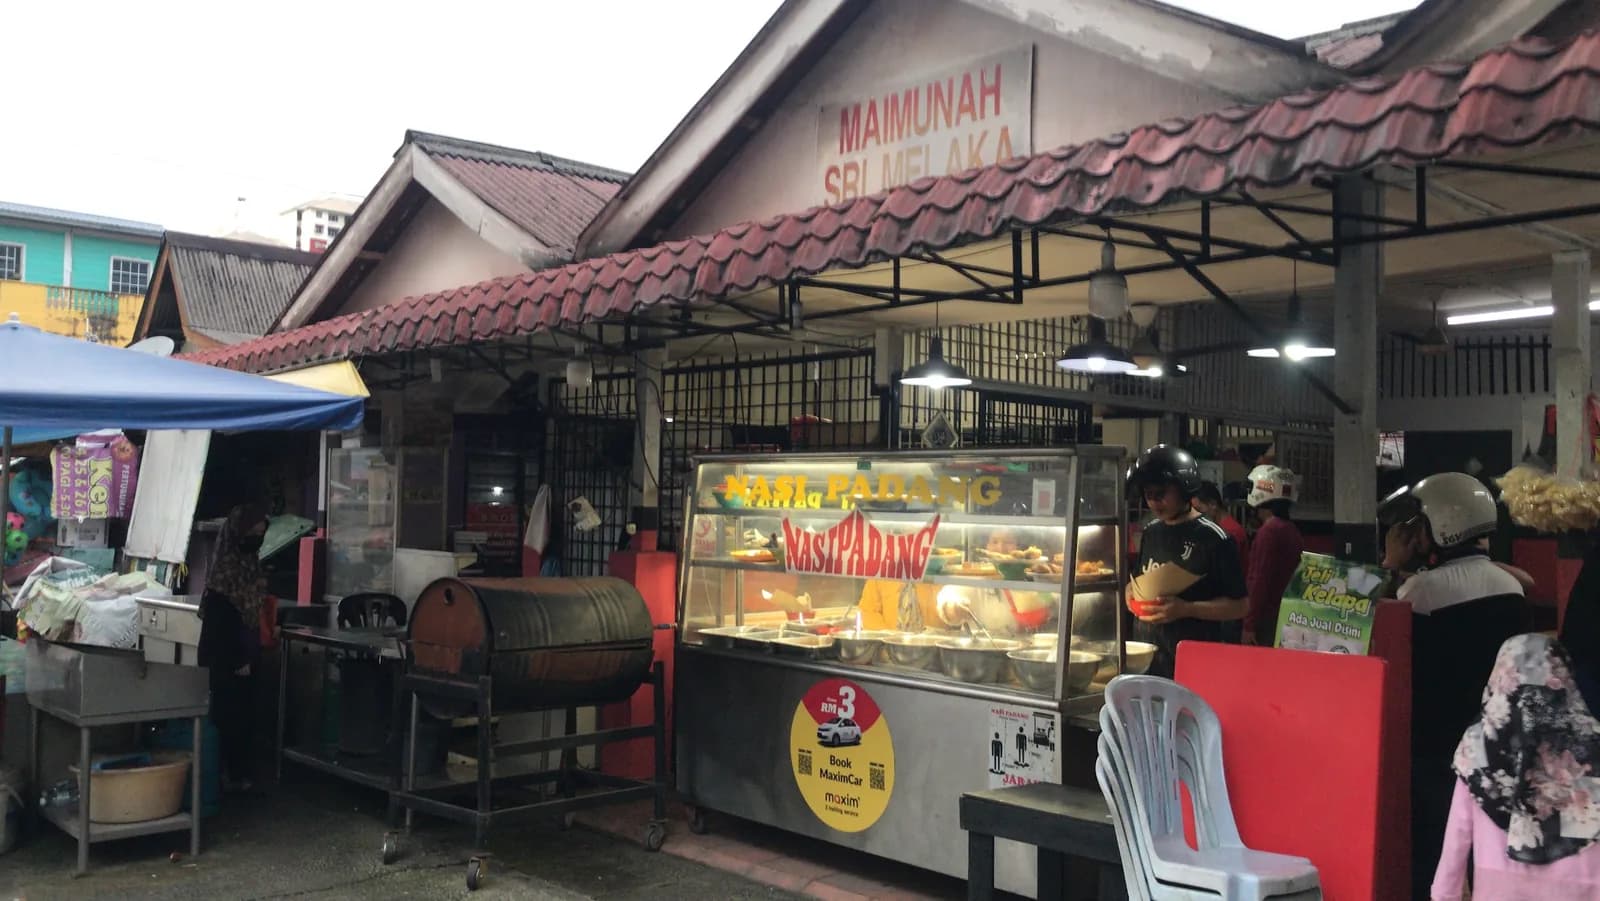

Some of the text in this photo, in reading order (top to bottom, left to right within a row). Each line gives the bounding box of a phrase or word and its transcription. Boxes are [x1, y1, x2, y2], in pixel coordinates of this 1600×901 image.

[840, 63, 1002, 155] MAIMUNAH
[824, 158, 868, 206] SRI
[725, 474, 808, 501] NASI
[826, 474, 1003, 507] PADANG
[1302, 583, 1370, 620] Kelapa
[1288, 611, 1361, 639] Ada Jual Disini
[820, 685, 856, 719] RM 3
[819, 767, 863, 787] MaximCar
[829, 754, 852, 769] Book
[825, 791, 859, 808] maxim
